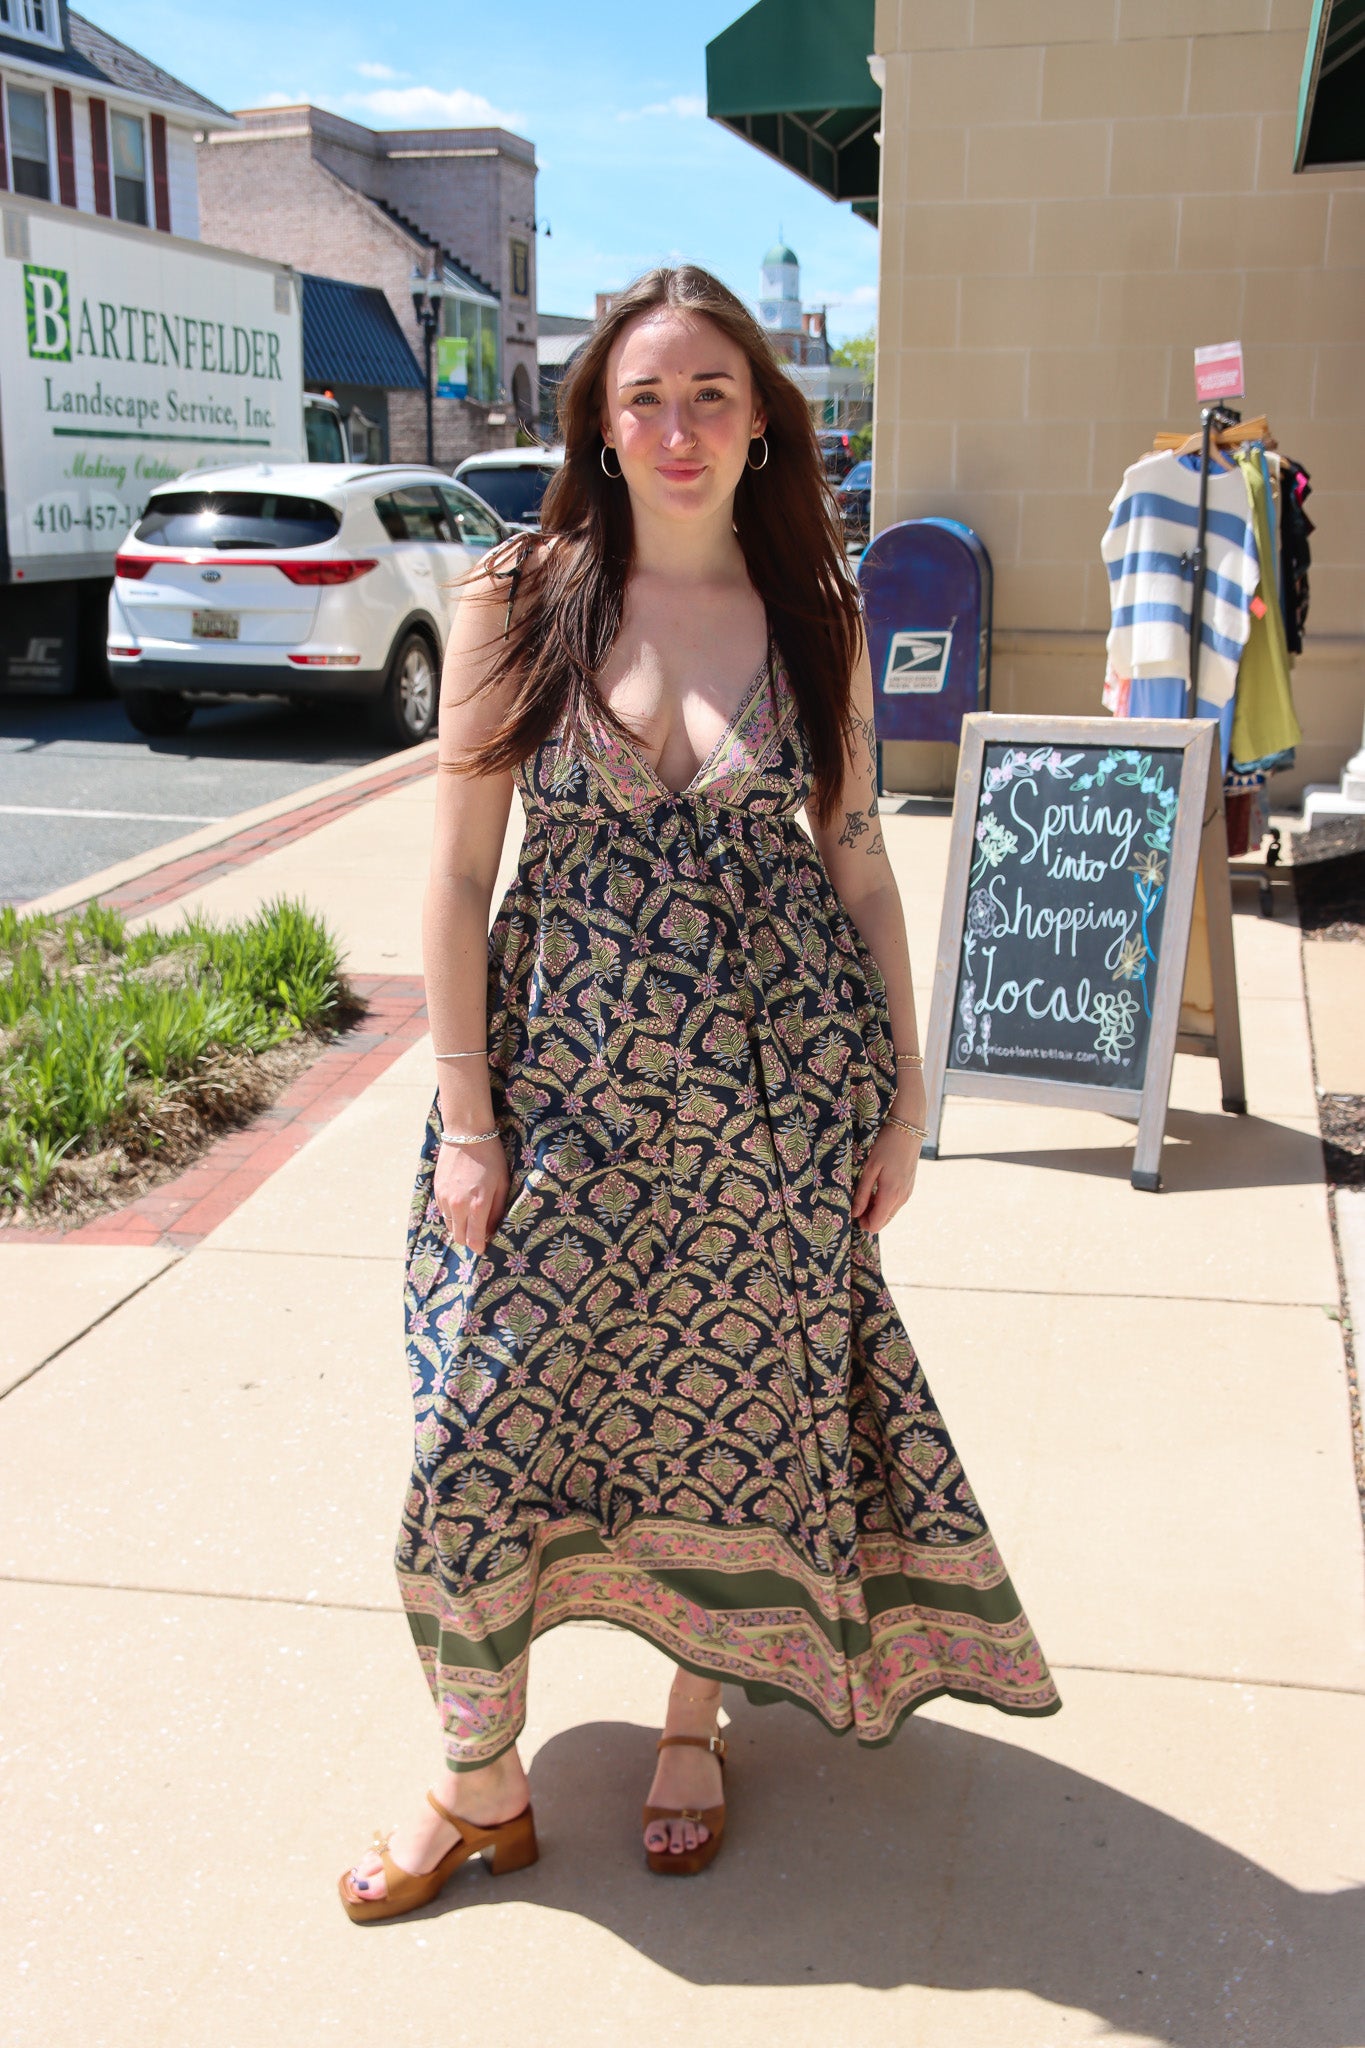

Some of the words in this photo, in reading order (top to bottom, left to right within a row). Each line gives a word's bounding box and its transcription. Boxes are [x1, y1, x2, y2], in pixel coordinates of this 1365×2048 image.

[28, 274, 283, 381] BARTENFELDER
[45, 377, 159, 429] Landscape
[167, 389, 238, 430] Service,
[246, 397, 275, 428] Inc.
[63, 452, 127, 490] Making
[1010, 778, 1142, 870] Spring
[1047, 847, 1108, 883] into
[988, 874, 1138, 971] Shopping
[973, 945, 1102, 1024] Local
